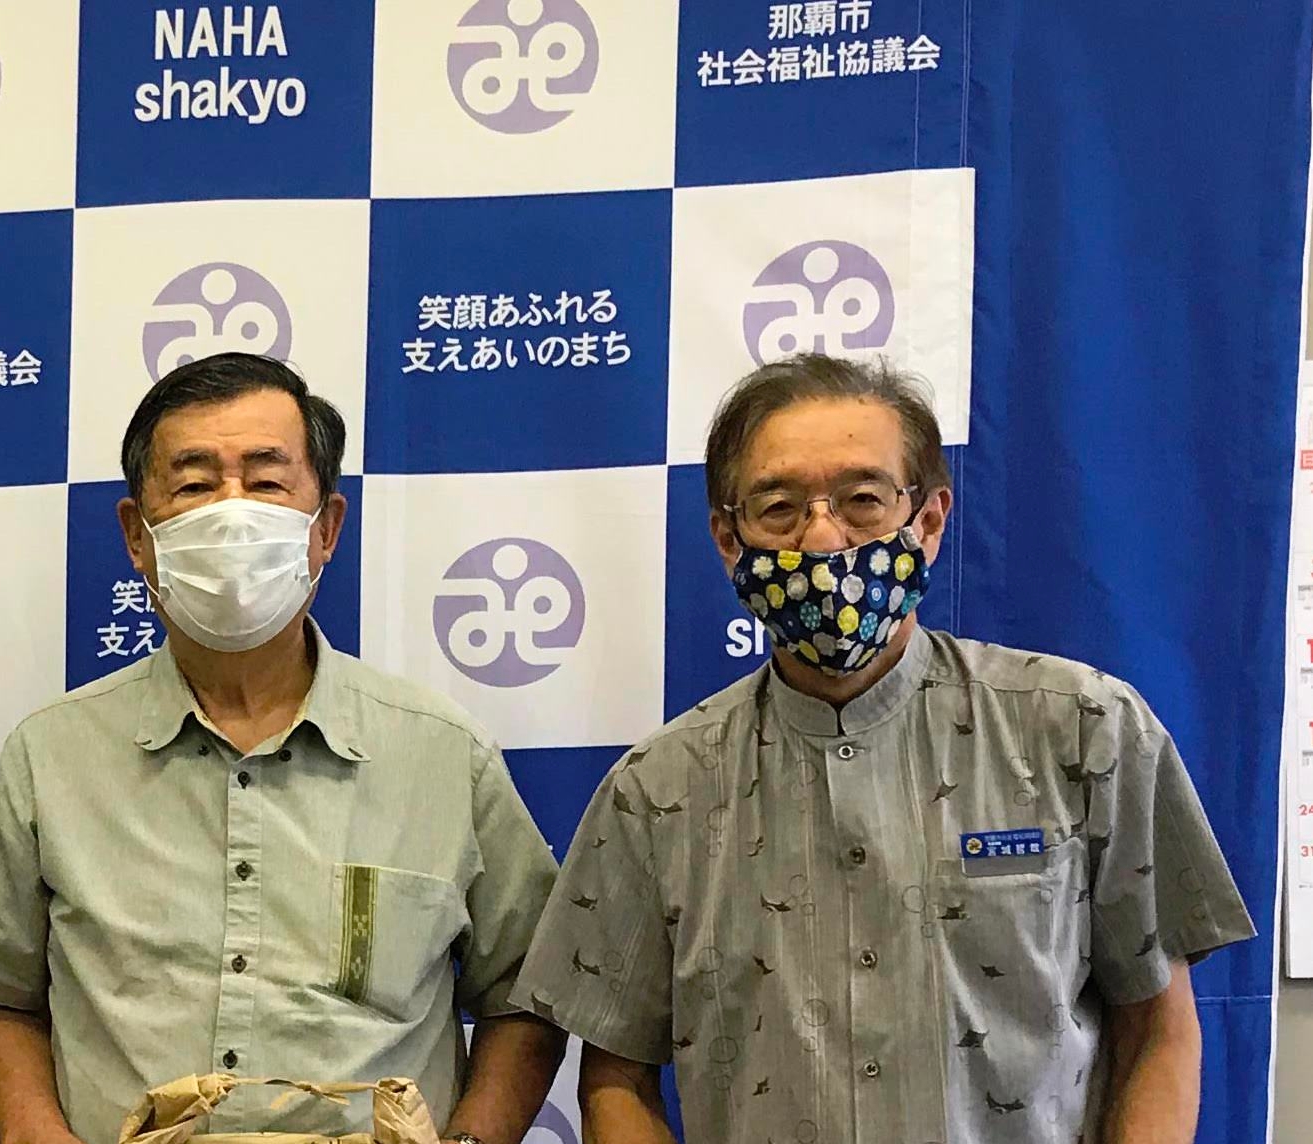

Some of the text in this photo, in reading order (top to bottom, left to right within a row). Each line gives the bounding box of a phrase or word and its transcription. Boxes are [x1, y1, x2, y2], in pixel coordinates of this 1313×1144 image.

[154, 6, 287, 59] NAHA
[768, 0, 871, 38] 那覇市
[697, 35, 941, 87] 社会福祉協議会
[135, 67, 306, 125] shakyo
[418, 288, 617, 332] 笑顔あふれる
[402, 329, 632, 375] 支えあいのまち
[112, 580, 155, 615] 笑
